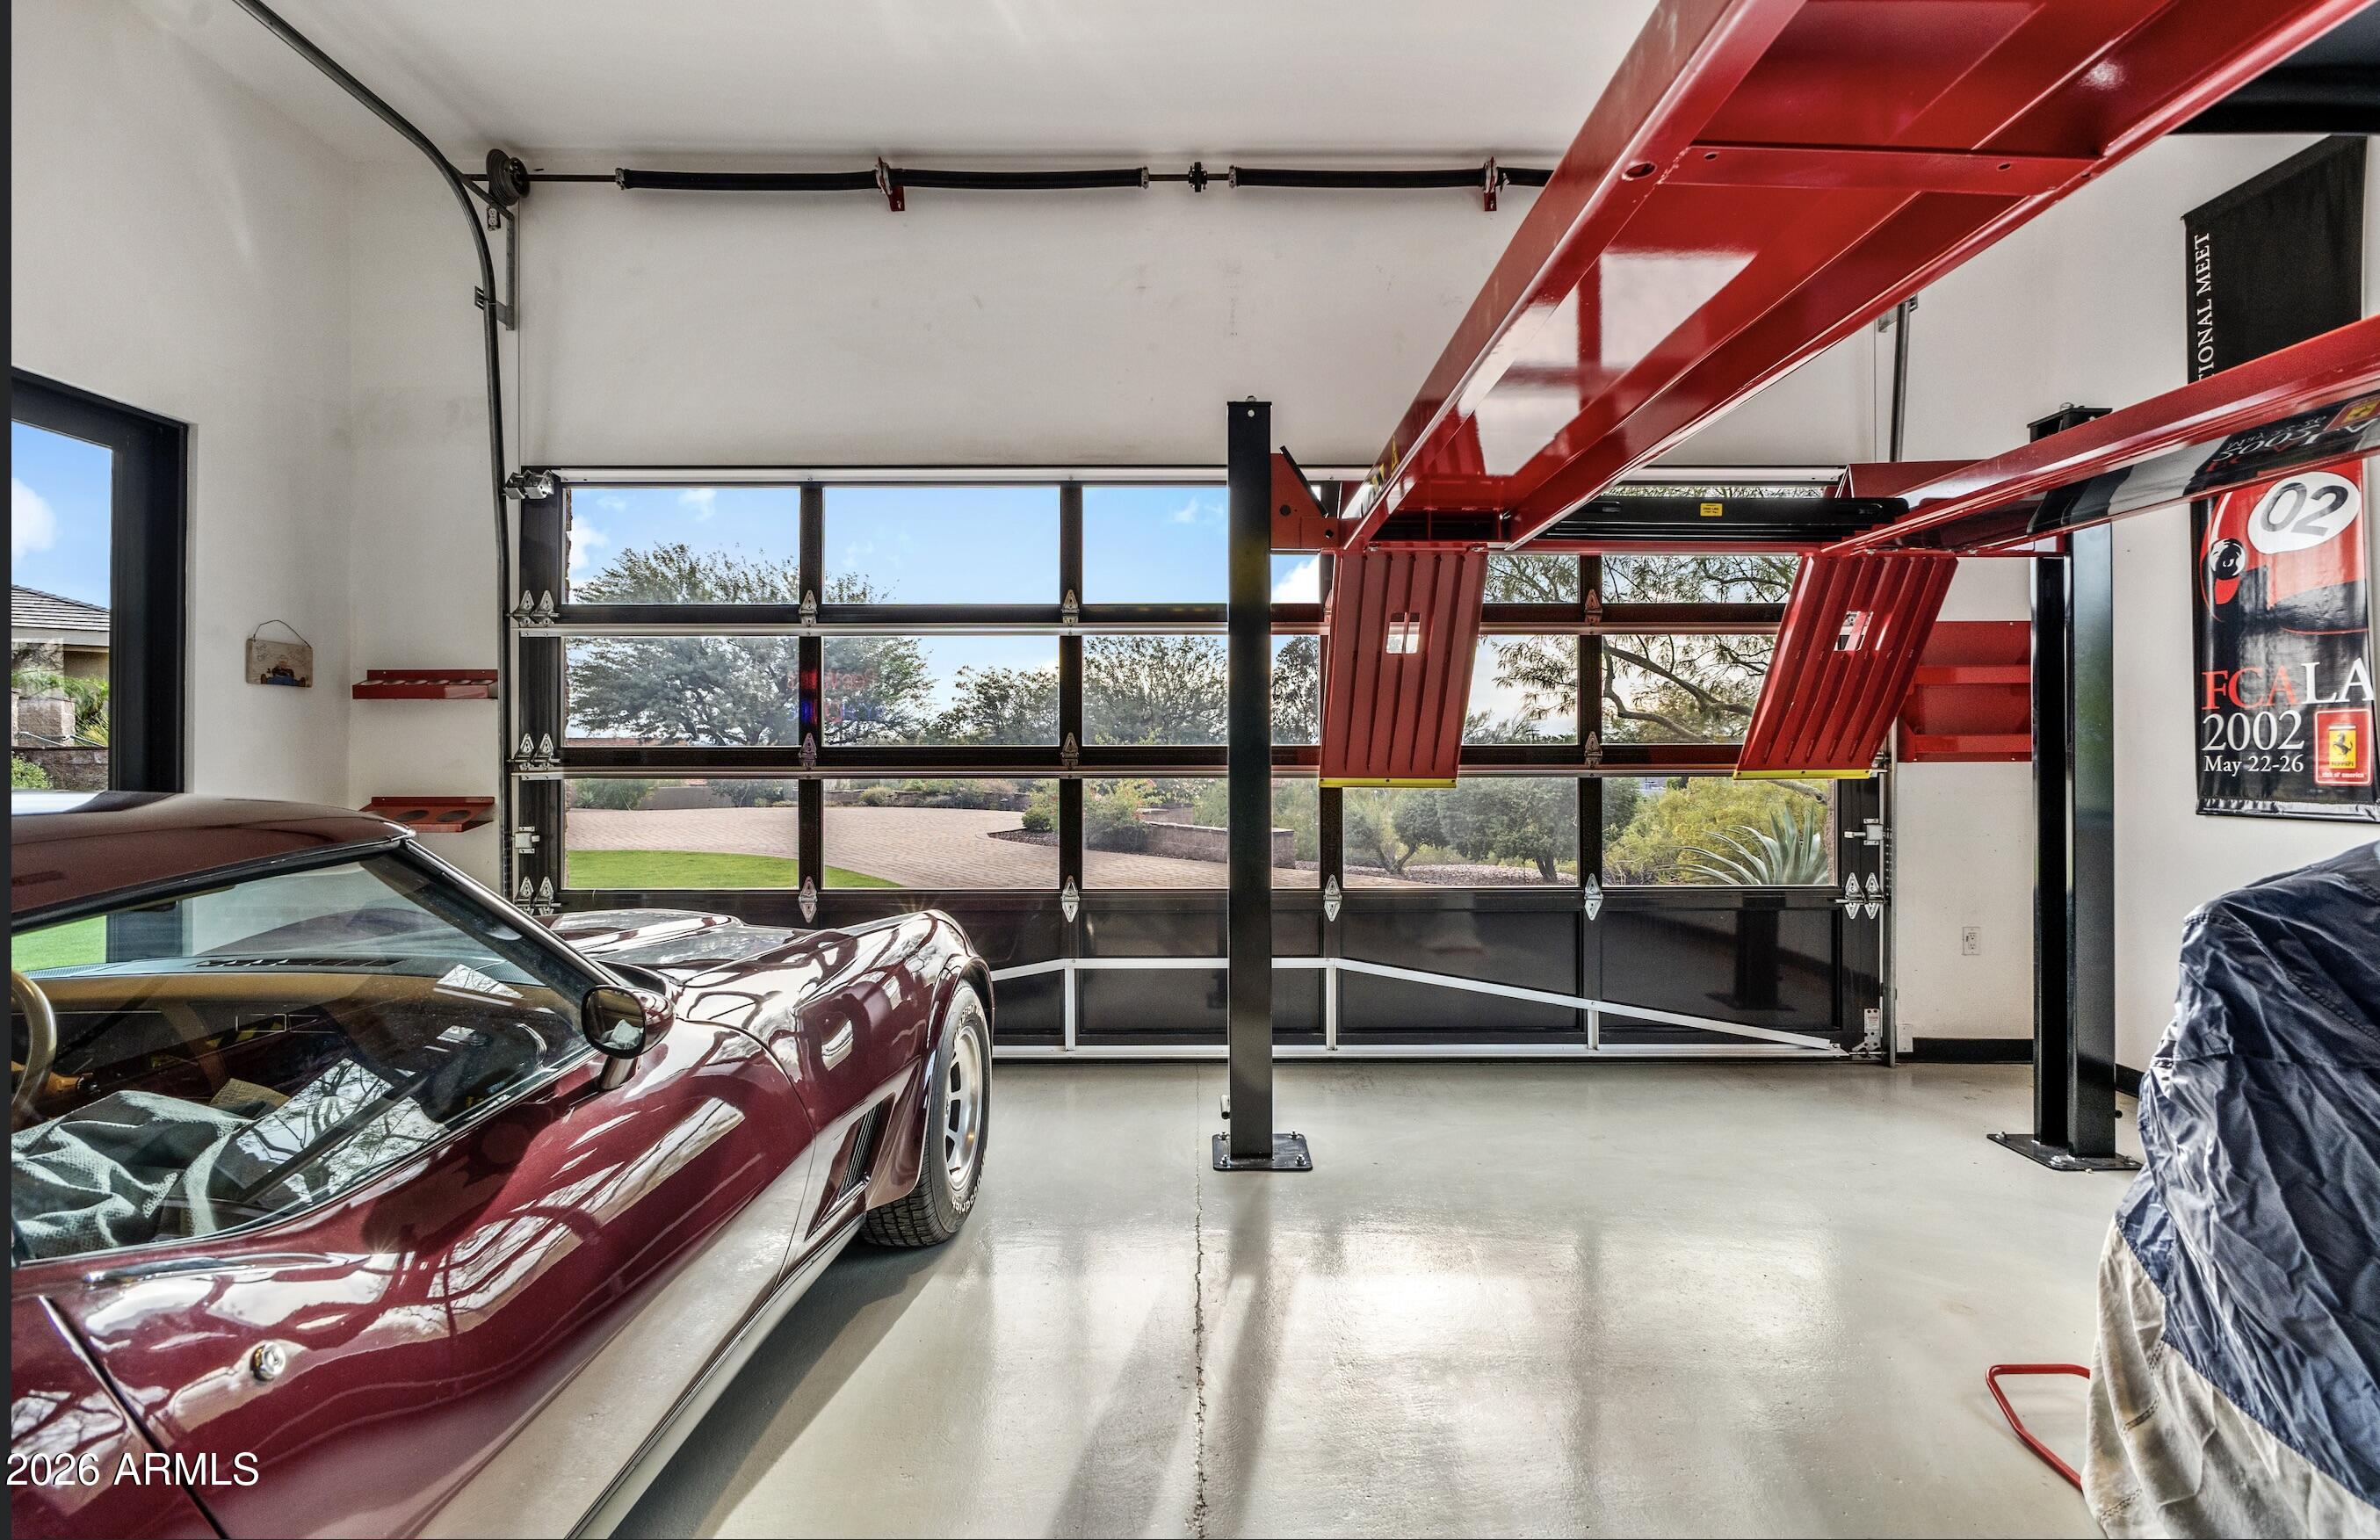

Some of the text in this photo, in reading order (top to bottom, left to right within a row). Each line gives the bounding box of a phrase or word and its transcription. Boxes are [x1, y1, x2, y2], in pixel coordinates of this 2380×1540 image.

[2194, 233, 2212, 297] MEET
[2261, 481, 2349, 538] 02
[2201, 657, 2375, 710] FCALA
[2202, 710, 2305, 751] 2002
[2203, 754, 2304, 777] May 22-26
